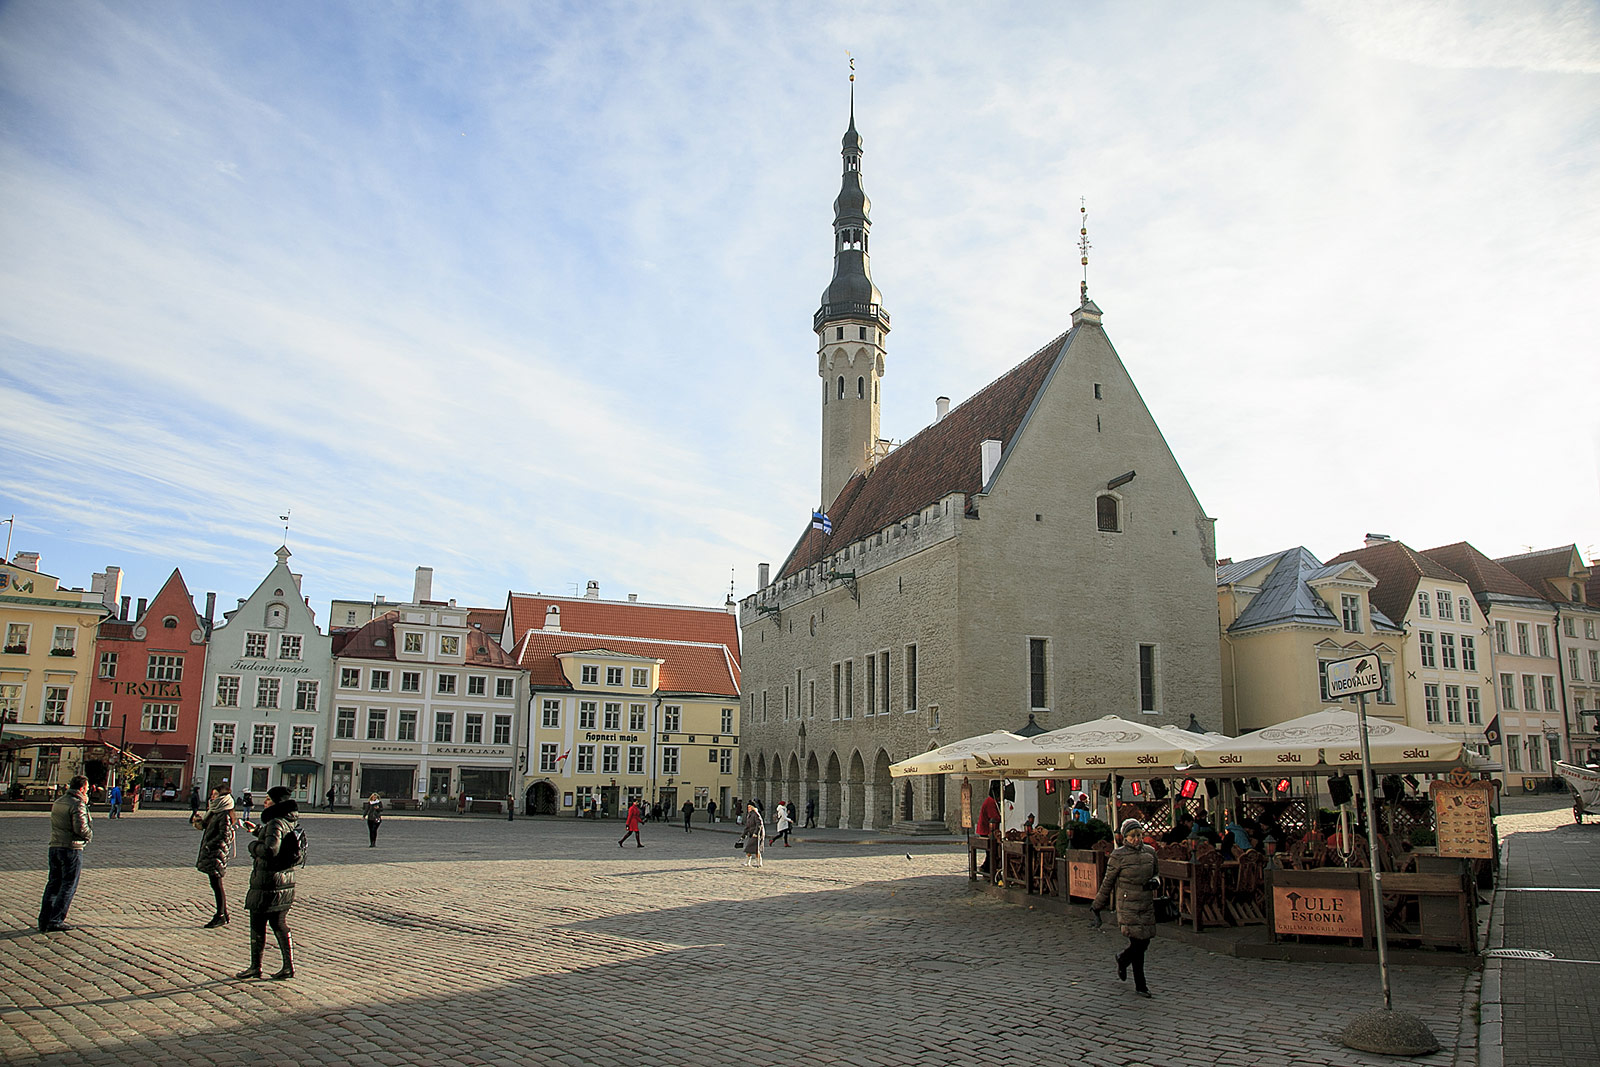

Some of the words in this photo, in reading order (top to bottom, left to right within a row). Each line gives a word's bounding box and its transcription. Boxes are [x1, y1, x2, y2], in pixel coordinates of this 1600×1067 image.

[230, 659, 311, 676] Tudengimaja
[1331, 673, 1378, 692] VIDEOVALVE
[109, 681, 182, 697] TROIKA
[618, 733, 638, 743] maja
[436, 747, 505, 755] KAERAJAAN
[1402, 748, 1430, 759] saku
[1036, 756, 1057, 766] saku
[1085, 755, 1106, 765] saku
[1136, 754, 1159, 764] saku
[1219, 753, 1242, 764] saku
[1277, 752, 1301, 763] saku
[903, 766, 918, 774] saku
[939, 763, 954, 771] saku
[1286, 892, 1344, 911] TULE
[1291, 912, 1344, 923] ESTONIA
